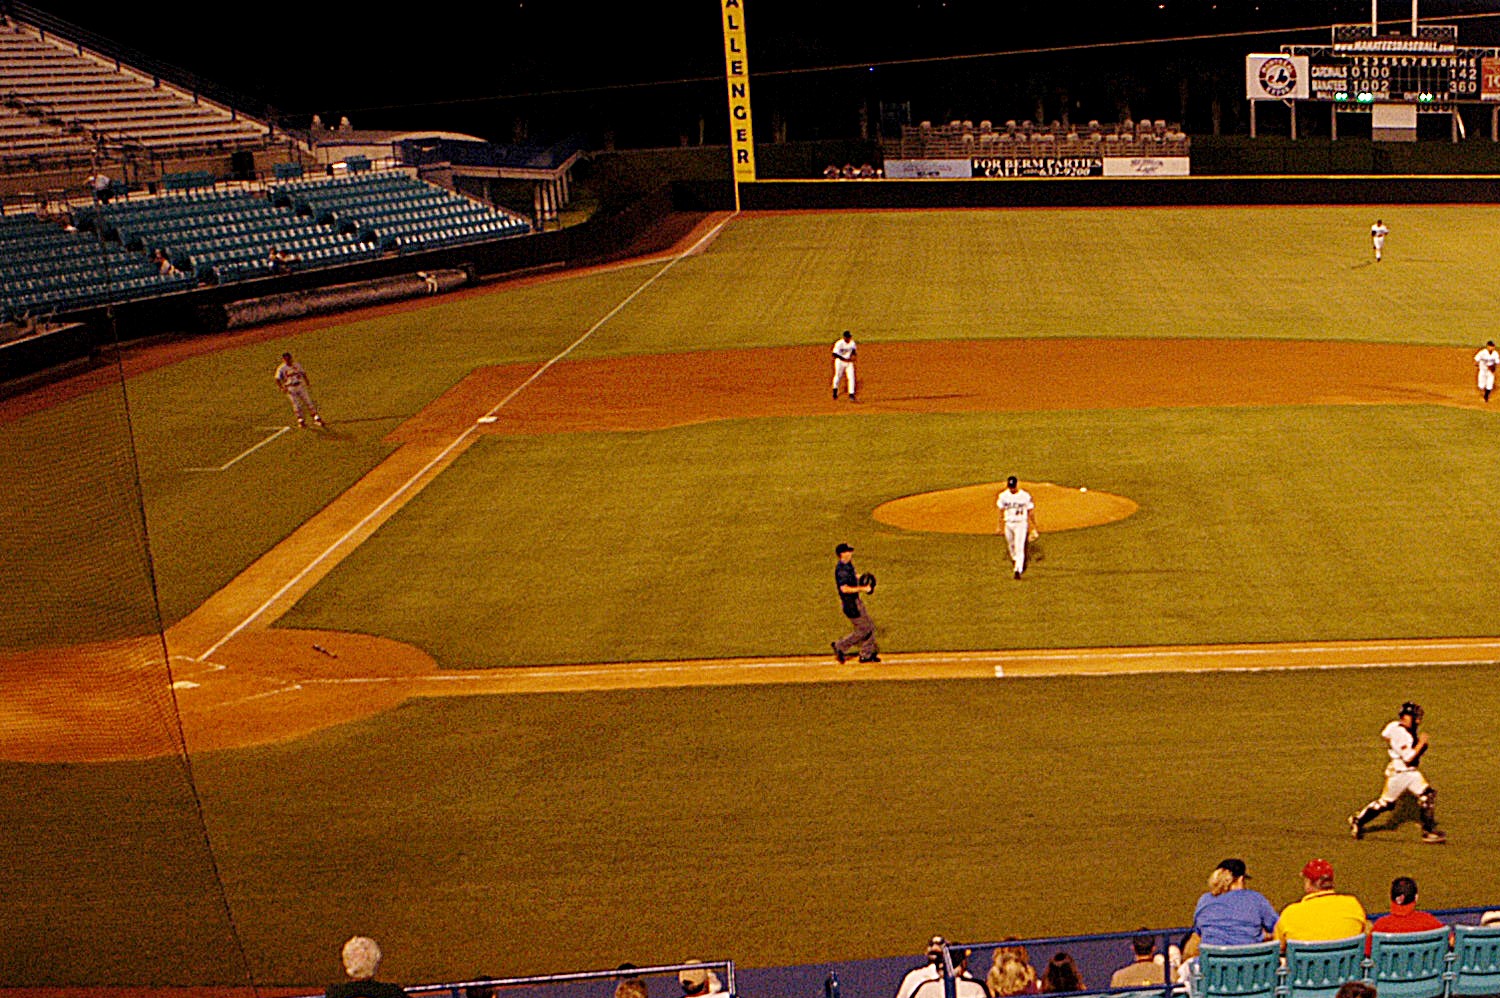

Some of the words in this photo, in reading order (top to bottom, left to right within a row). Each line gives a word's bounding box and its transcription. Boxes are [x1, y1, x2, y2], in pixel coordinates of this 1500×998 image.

[973, 159, 1001, 168] FOR
[1005, 158, 1043, 168] BERM
[1047, 158, 1102, 167] PARTIES
[985, 167, 1022, 177] CALL
